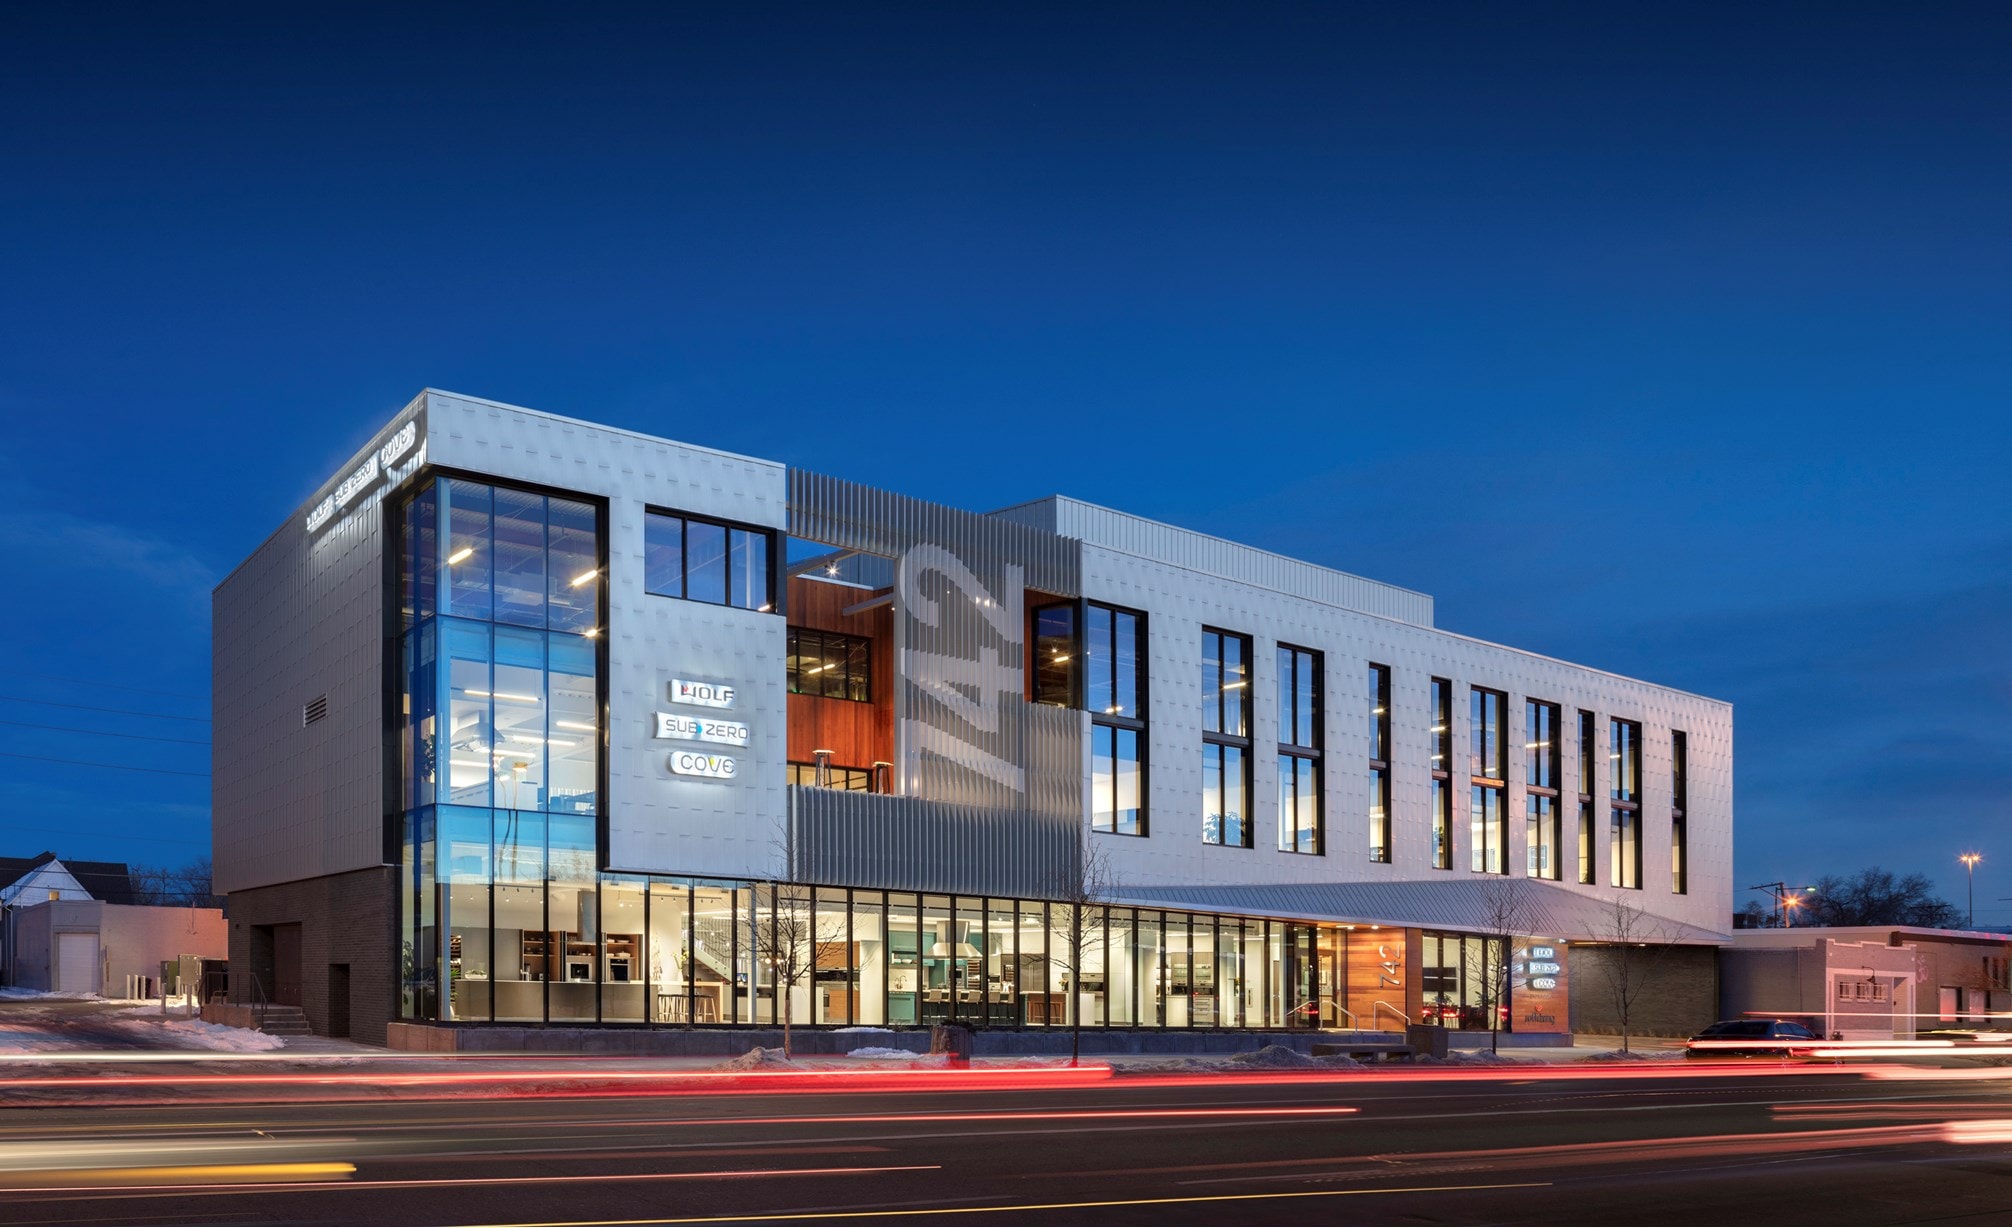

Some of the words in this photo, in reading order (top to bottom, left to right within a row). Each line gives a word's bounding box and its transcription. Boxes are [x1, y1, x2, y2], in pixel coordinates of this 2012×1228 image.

[351, 461, 372, 487] ZERO
[900, 542, 1025, 798] 742
[681, 684, 734, 702] WOLF
[665, 719, 699, 734] SUB
[705, 723, 748, 740] ZERO
[680, 754, 735, 774] COVE
[1379, 944, 1401, 988] 742
